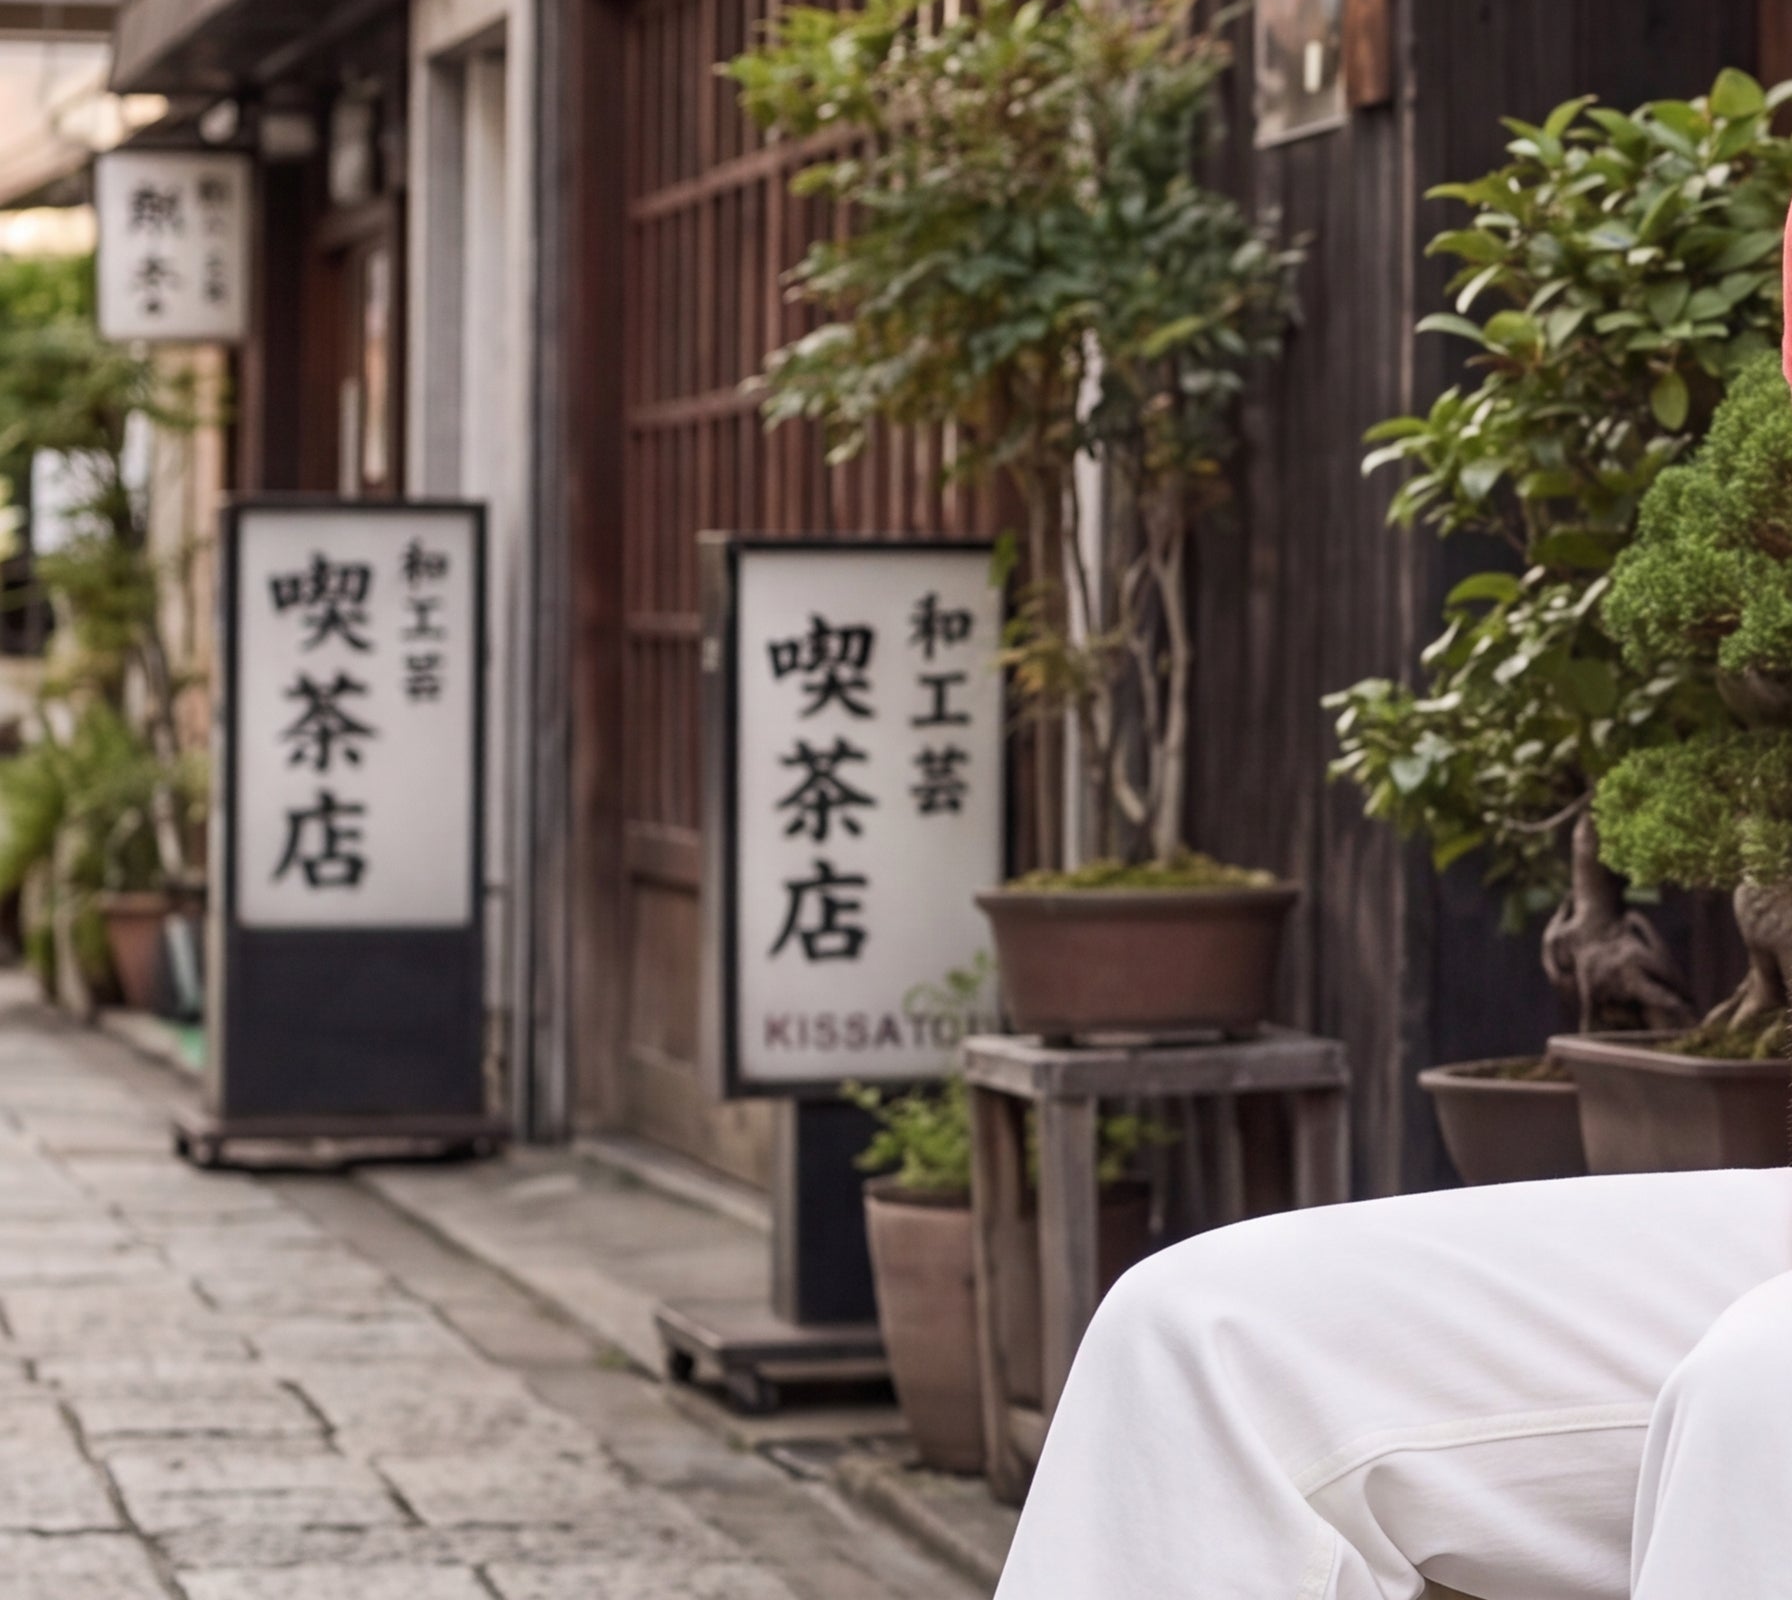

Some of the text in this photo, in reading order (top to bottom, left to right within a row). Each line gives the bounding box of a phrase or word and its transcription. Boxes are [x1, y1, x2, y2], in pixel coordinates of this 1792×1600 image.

[268, 550, 376, 892] 喫茶店
[766, 612, 877, 963] 喫茶店
[910, 591, 975, 817] 和工芸
